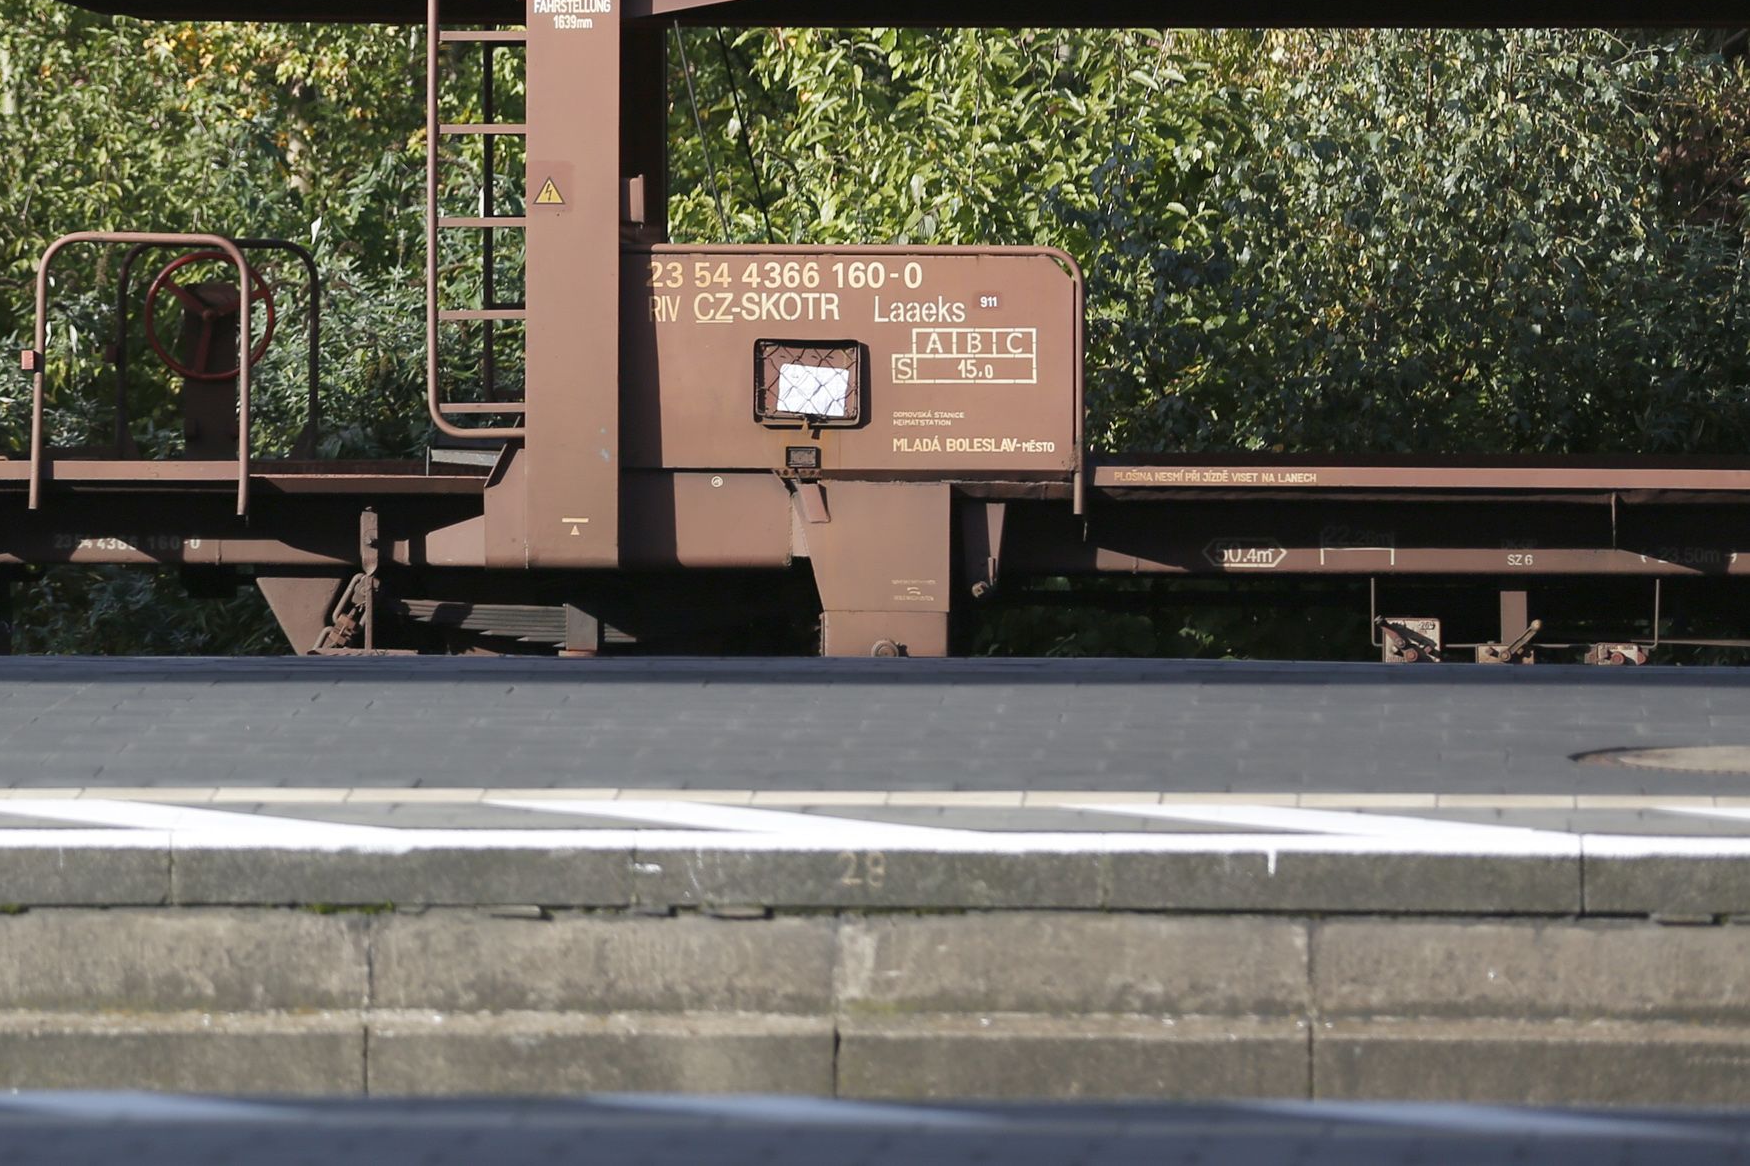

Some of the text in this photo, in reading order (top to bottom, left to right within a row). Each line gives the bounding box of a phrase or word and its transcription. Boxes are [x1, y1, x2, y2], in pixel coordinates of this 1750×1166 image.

[553, 14, 593, 29] 1639mm
[646, 261, 683, 288] 23
[694, 261, 732, 288] 54
[741, 261, 820, 288] 4366
[648, 291, 840, 323] RIV CZ-SKOTR
[873, 295, 966, 323] Laaeks
[980, 296, 998, 308] 911
[926, 332, 943, 354] A
[966, 332, 982, 354] B
[1006, 332, 1023, 354] C
[897, 358, 912, 379] S
[893, 435, 942, 452] MLADÁ
[1231, 472, 1258, 483] VISET
[1262, 472, 1275, 483] NA
[1278, 472, 1316, 483] LANECH
